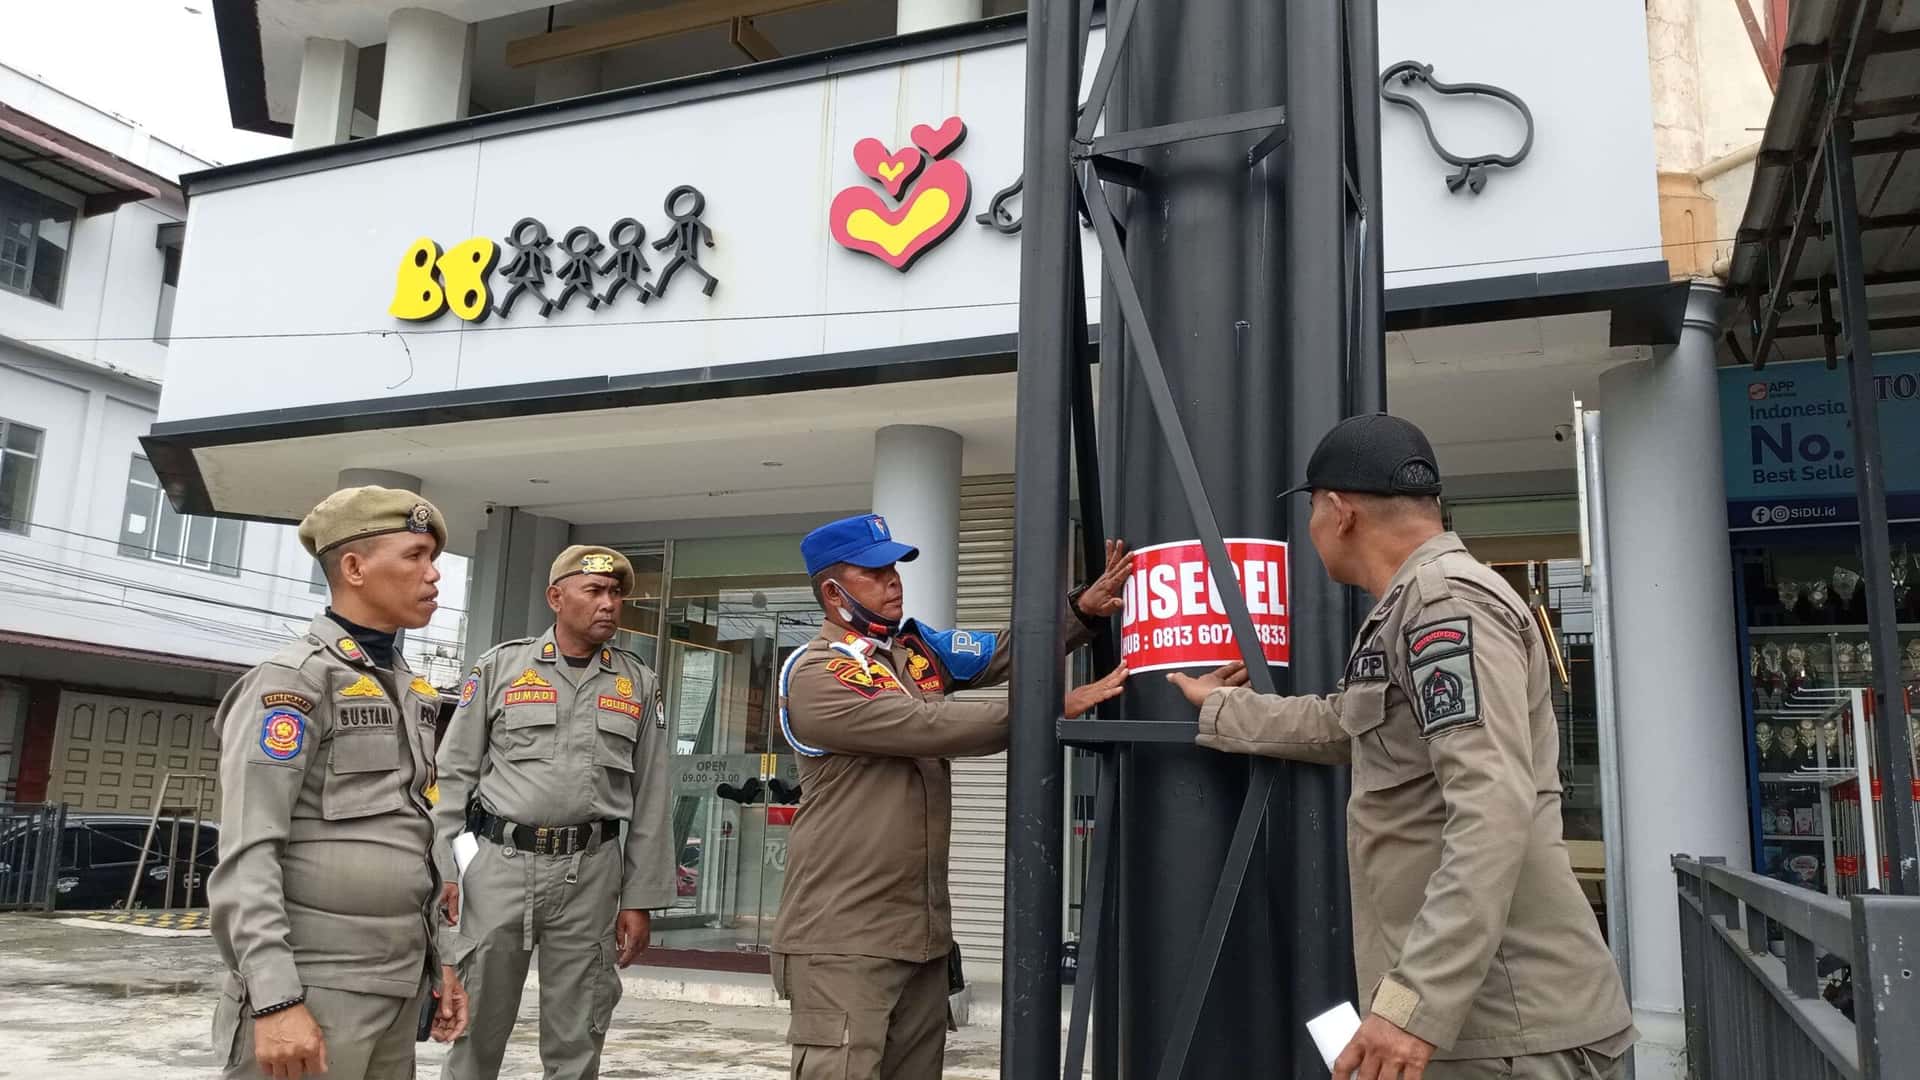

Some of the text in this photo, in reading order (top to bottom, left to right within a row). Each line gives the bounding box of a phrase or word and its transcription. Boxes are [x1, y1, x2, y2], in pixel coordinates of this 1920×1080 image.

[1769, 381, 1794, 392] APP
[1873, 374, 1920, 400] TO
[1750, 400, 1848, 420] Indonesia
[1751, 421, 1850, 465] No.
[1753, 464, 1855, 484] Best Selle
[1153, 625, 1193, 649] 0813
[1198, 624, 1234, 645] 607
[507, 690, 554, 704] JUMADI
[696, 761, 727, 772] OPEN
[682, 774, 707, 782] 09.00
